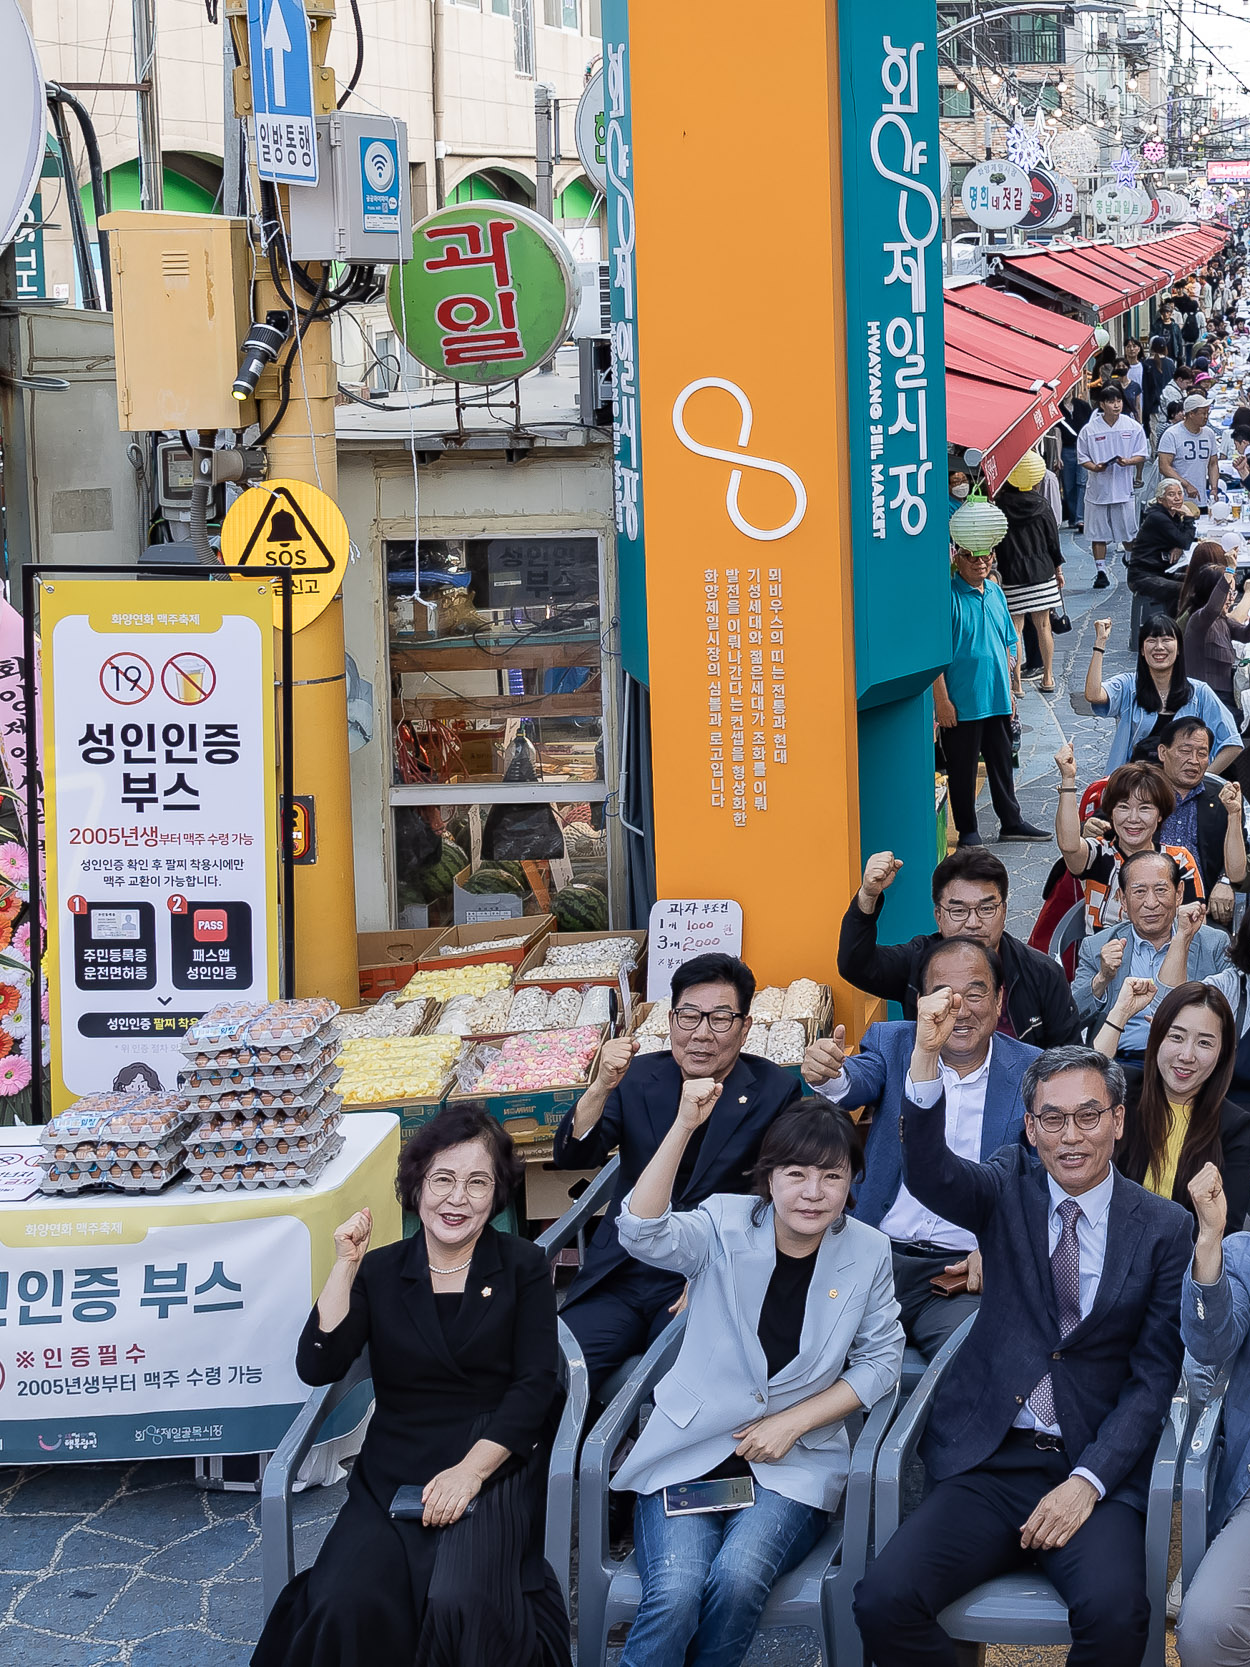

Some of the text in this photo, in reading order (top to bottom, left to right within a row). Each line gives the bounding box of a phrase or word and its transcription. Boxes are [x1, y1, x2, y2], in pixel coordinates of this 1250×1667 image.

[260, 122, 312, 167] 일방통행
[425, 221, 525, 366] 과일
[870, 35, 939, 536] 화양제일시장
[867, 321, 883, 420] HWAYANG
[870, 424, 884, 460] JEIL
[1184, 440, 1209, 461] 35
[265, 550, 307, 567] SOS
[725, 568, 740, 615] 발전을
[747, 567, 763, 645] 기성세대와
[111, 613, 200, 626] 화양연화 맥주축제
[768, 568, 787, 764] 뫼비우스의 띠는 전통과 현대
[110, 665, 142, 692] 19
[704, 568, 725, 808] 화양제일시장의 심볼과 로고입니다
[78, 723, 241, 765] 성인인증
[752, 731, 766, 777] 조화를
[121, 772, 201, 813] 부스
[732, 765, 747, 827] 형상화한
[183, 833, 206, 846] 맥주
[207, 833, 230, 846] 수령
[232, 833, 255, 846] 가능
[80, 858, 244, 871] 성인인증 확인 후 팔찌 착용시에만
[103, 875, 222, 888] 맥주 교환이 가능합니다.
[73, 896, 82, 912] 1
[172, 896, 183, 912] 2
[667, 902, 699, 916] 과자
[198, 920, 224, 931] PASS
[682, 936, 720, 952] 2000
[83, 949, 148, 962] 주민등록증
[192, 949, 231, 962] 패스앱
[84, 966, 148, 980] 운전면허증
[186, 966, 237, 980] 성인인증
[107, 1017, 151, 1030] 성인인증
[153, 1017, 176, 1030] 팔찌
[25, 1221, 123, 1238] 화양연화 맥주축제
[0, 1260, 244, 1327] 인증 부스
[17, 1364, 263, 1397] 2005년생부터 맥주 수령 가능
